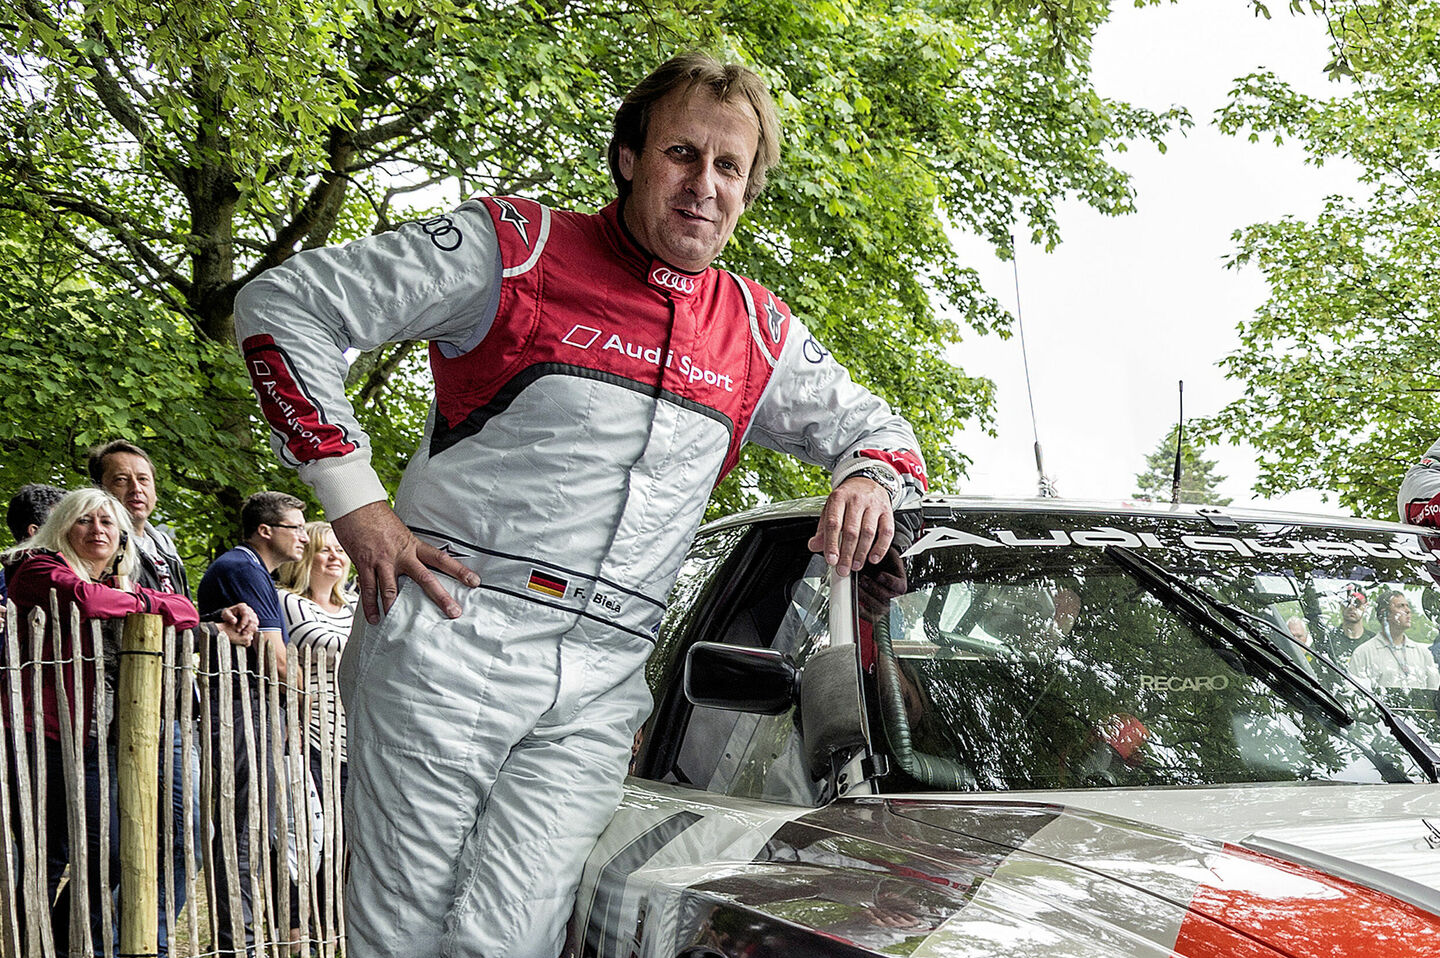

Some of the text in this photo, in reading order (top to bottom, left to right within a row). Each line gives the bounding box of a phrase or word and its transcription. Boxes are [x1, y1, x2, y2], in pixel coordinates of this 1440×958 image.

[602, 334, 734, 392] Audi Sport
[261, 379, 296, 418] Audi
[899, 525, 1166, 559] Audi
[573, 587, 622, 614] F. Biela
[1140, 674, 1229, 692] RECARO
